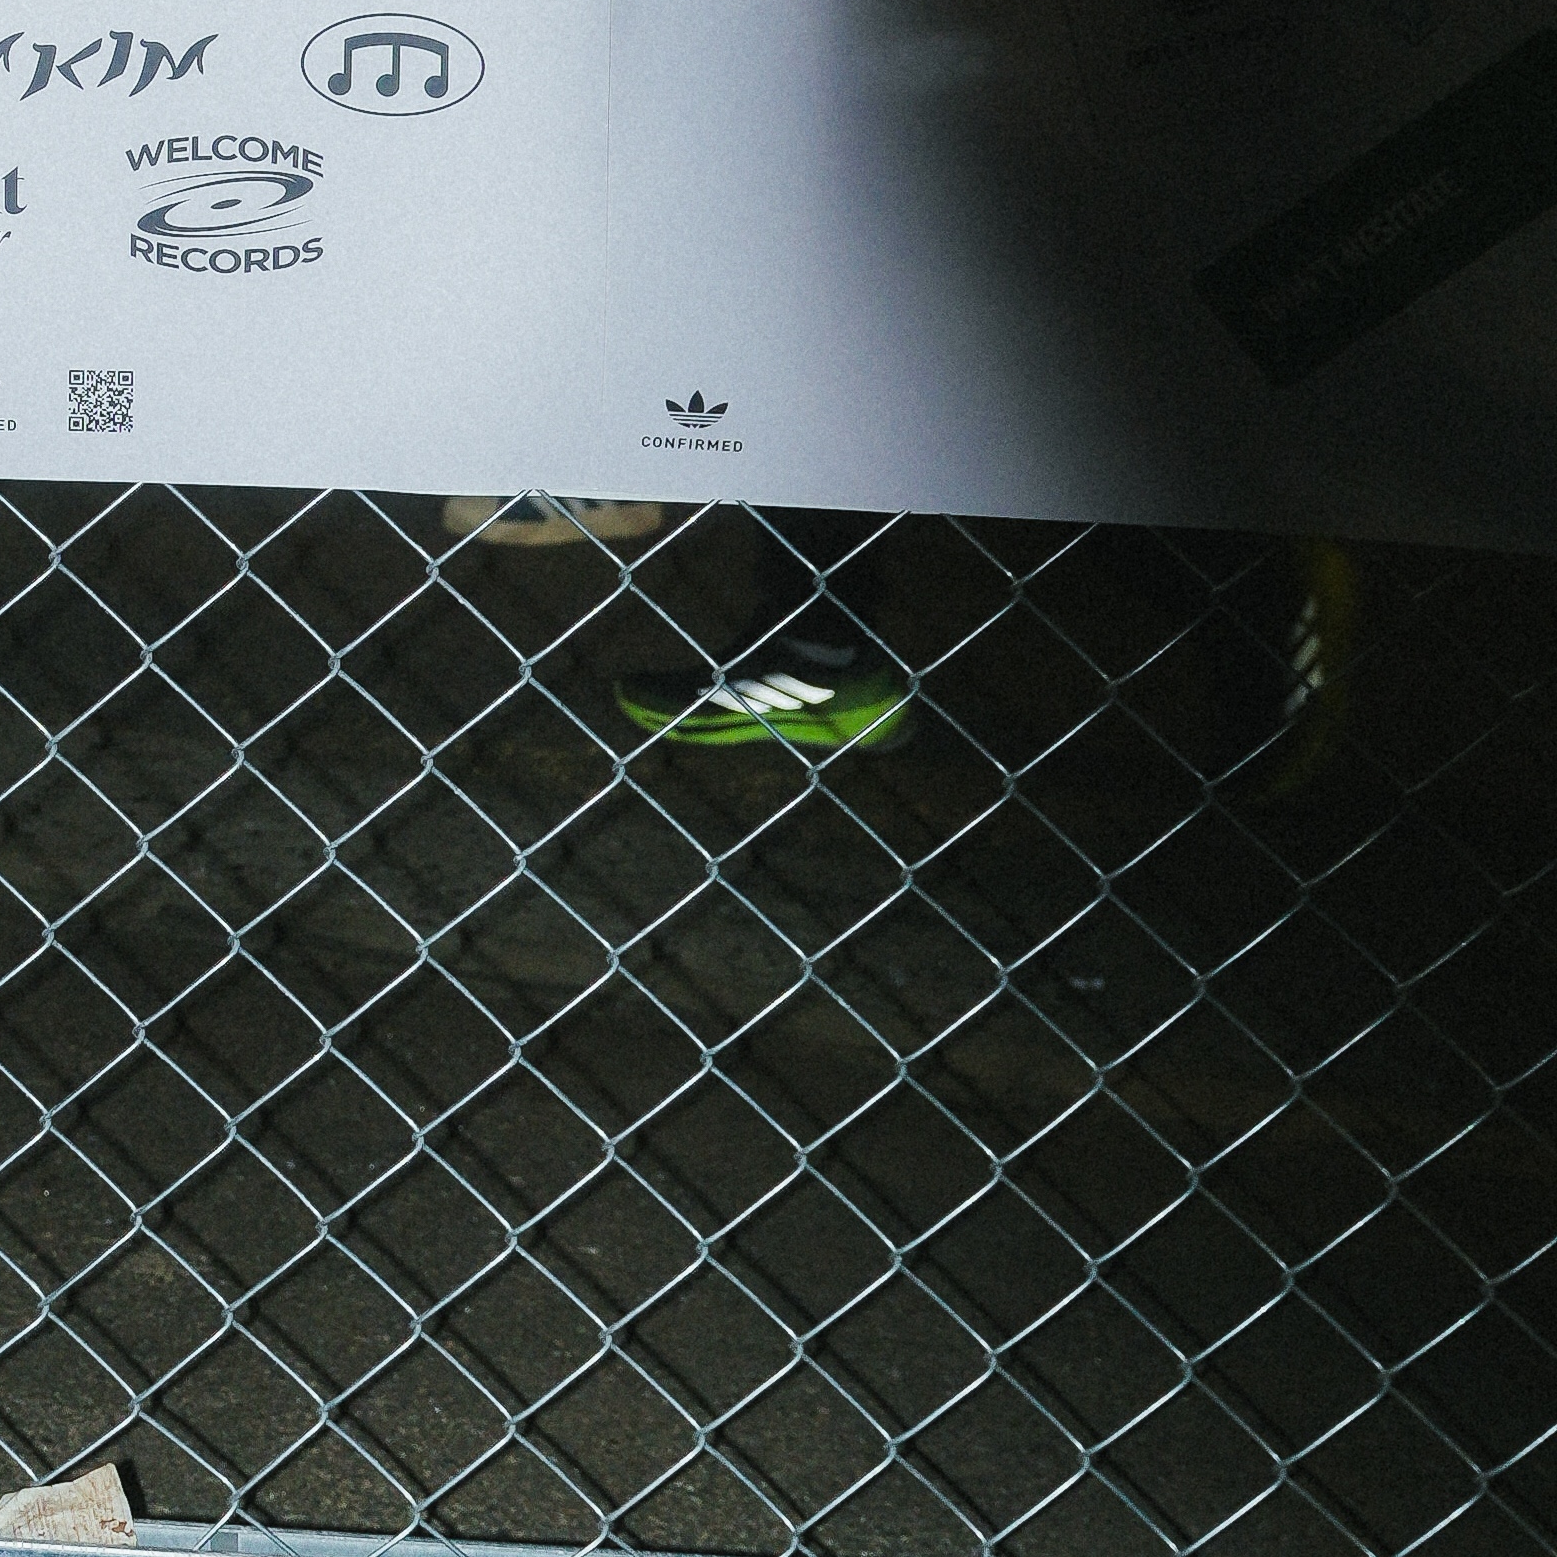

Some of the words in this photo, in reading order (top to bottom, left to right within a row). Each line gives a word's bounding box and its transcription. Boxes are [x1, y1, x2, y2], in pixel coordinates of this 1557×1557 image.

[126, 134, 325, 179] WELCOME
[129, 234, 325, 274] RECORDS
[642, 436, 743, 452] CONFIRMED
